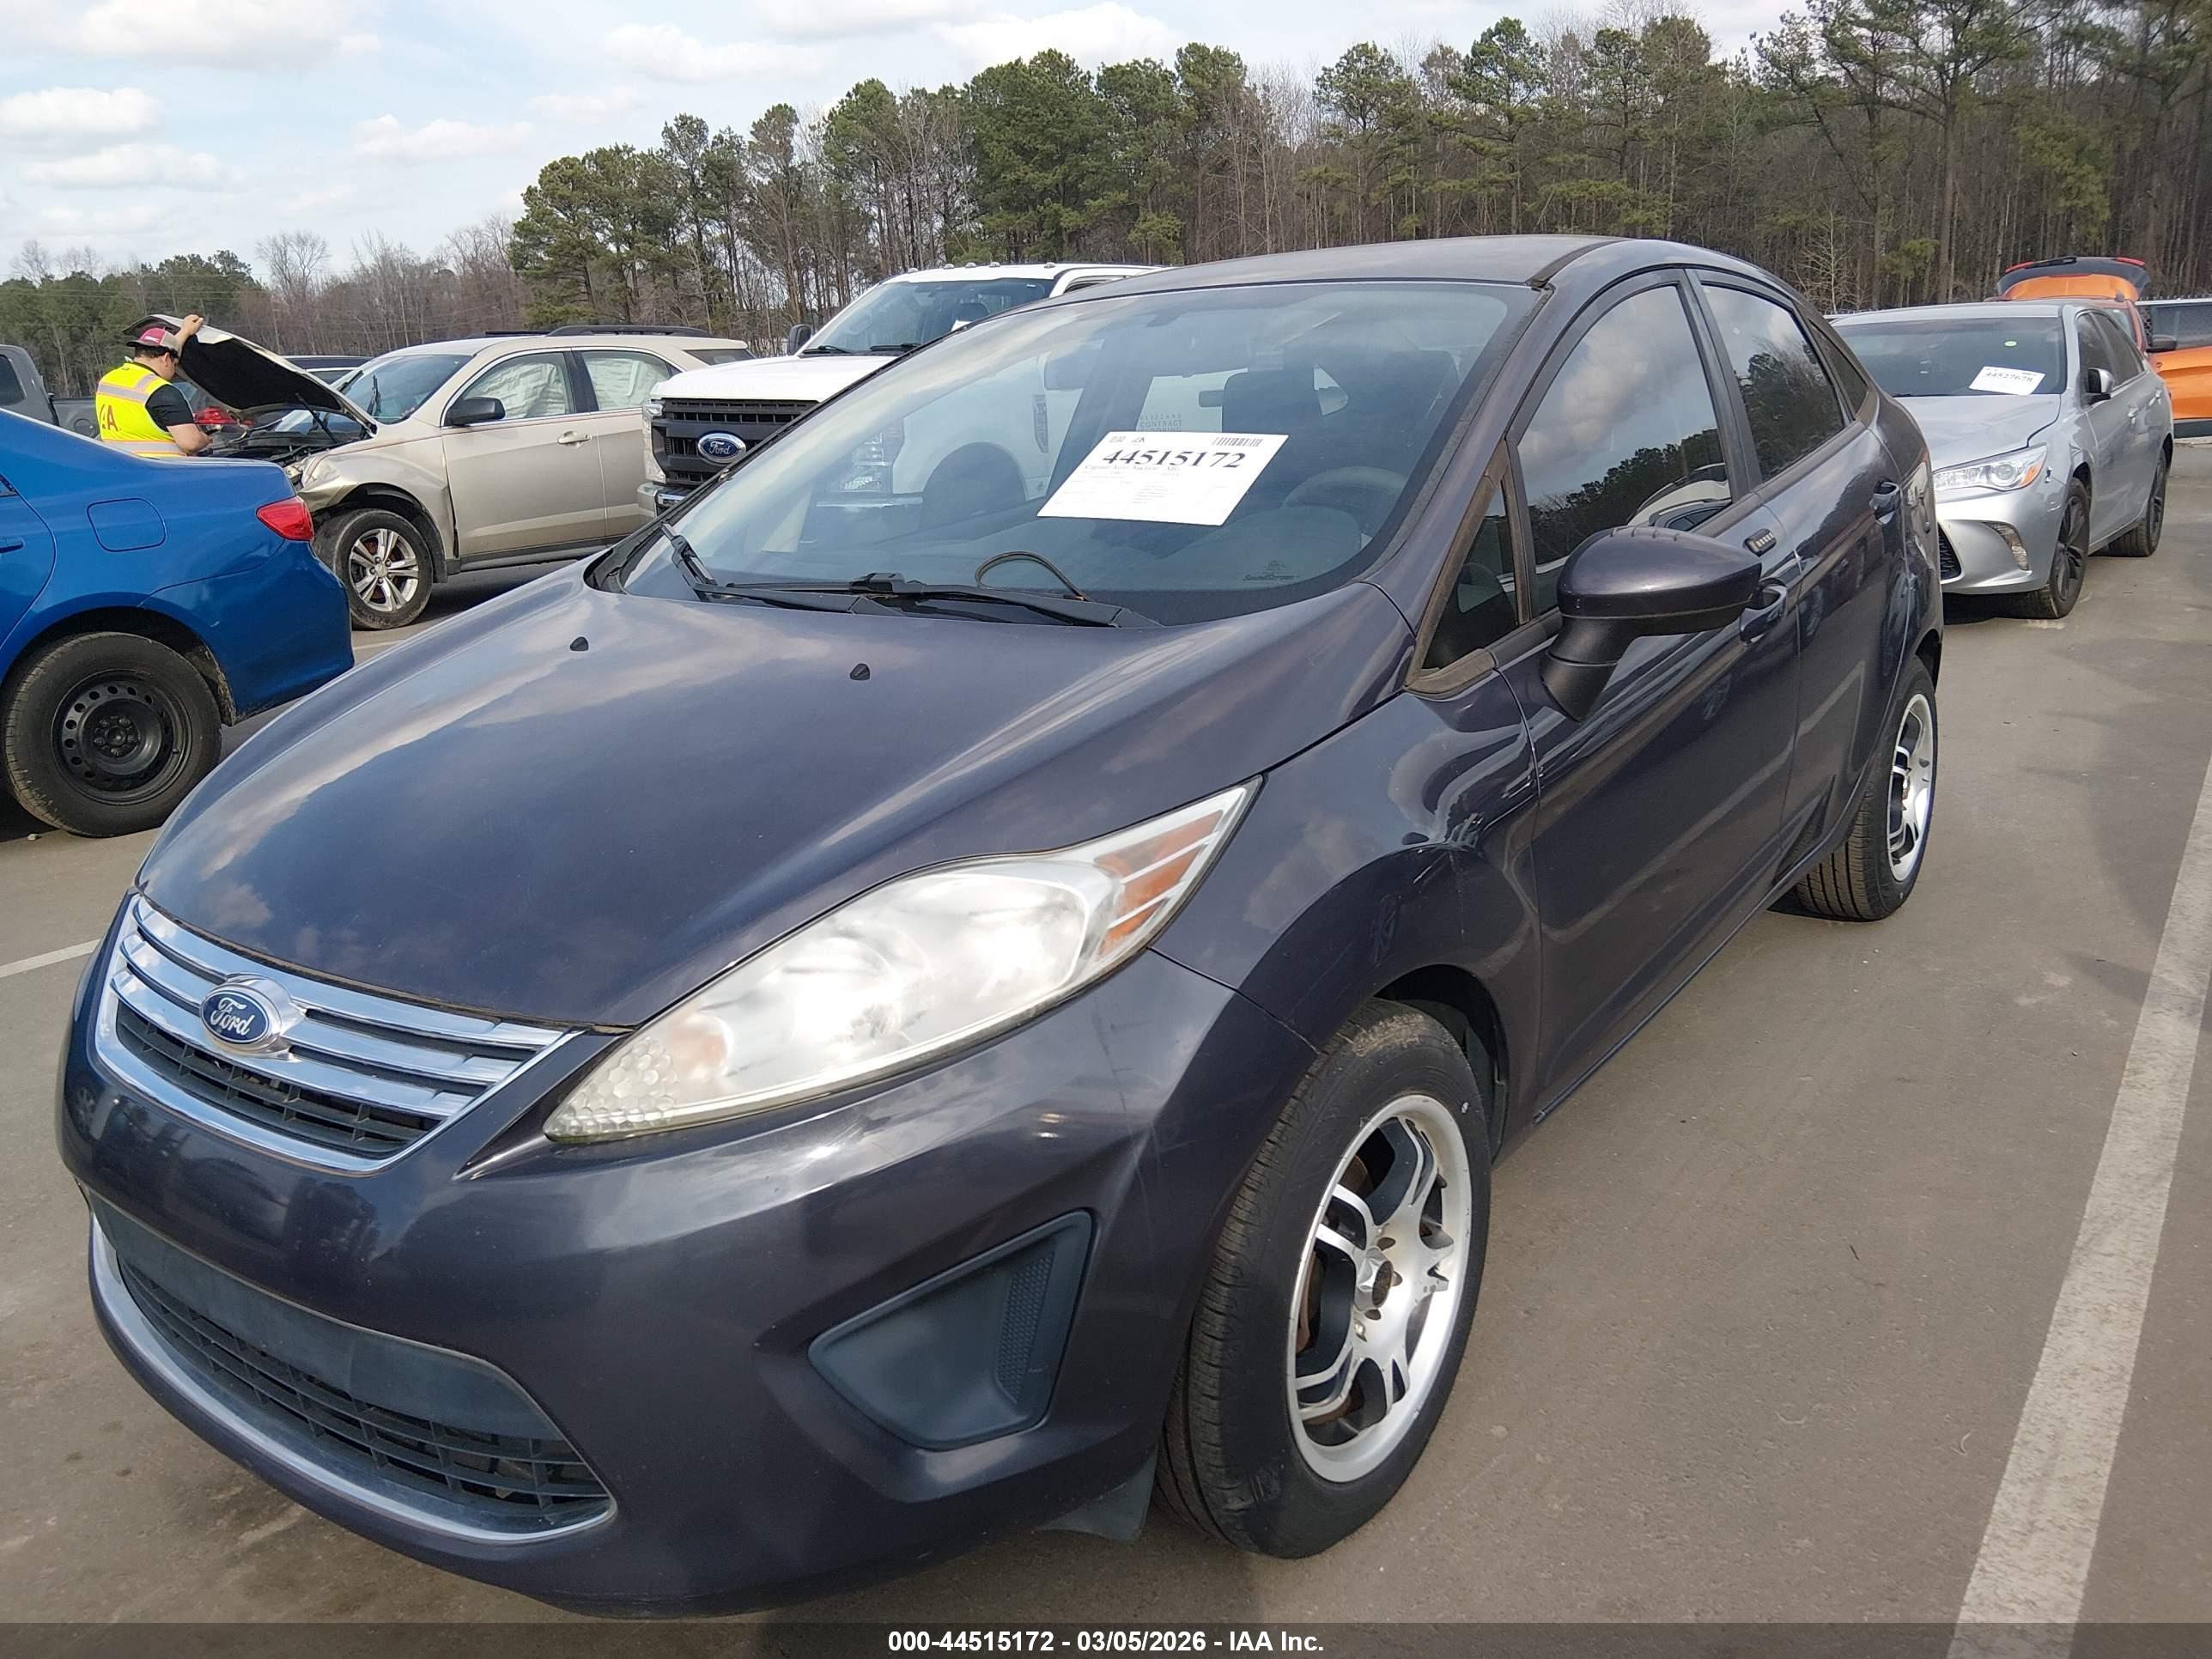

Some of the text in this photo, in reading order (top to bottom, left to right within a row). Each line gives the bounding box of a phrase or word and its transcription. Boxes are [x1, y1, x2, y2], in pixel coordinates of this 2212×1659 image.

[708, 441, 732, 455] Ford
[1103, 449, 1246, 467] 44515172
[210, 997, 251, 1036] Ford
